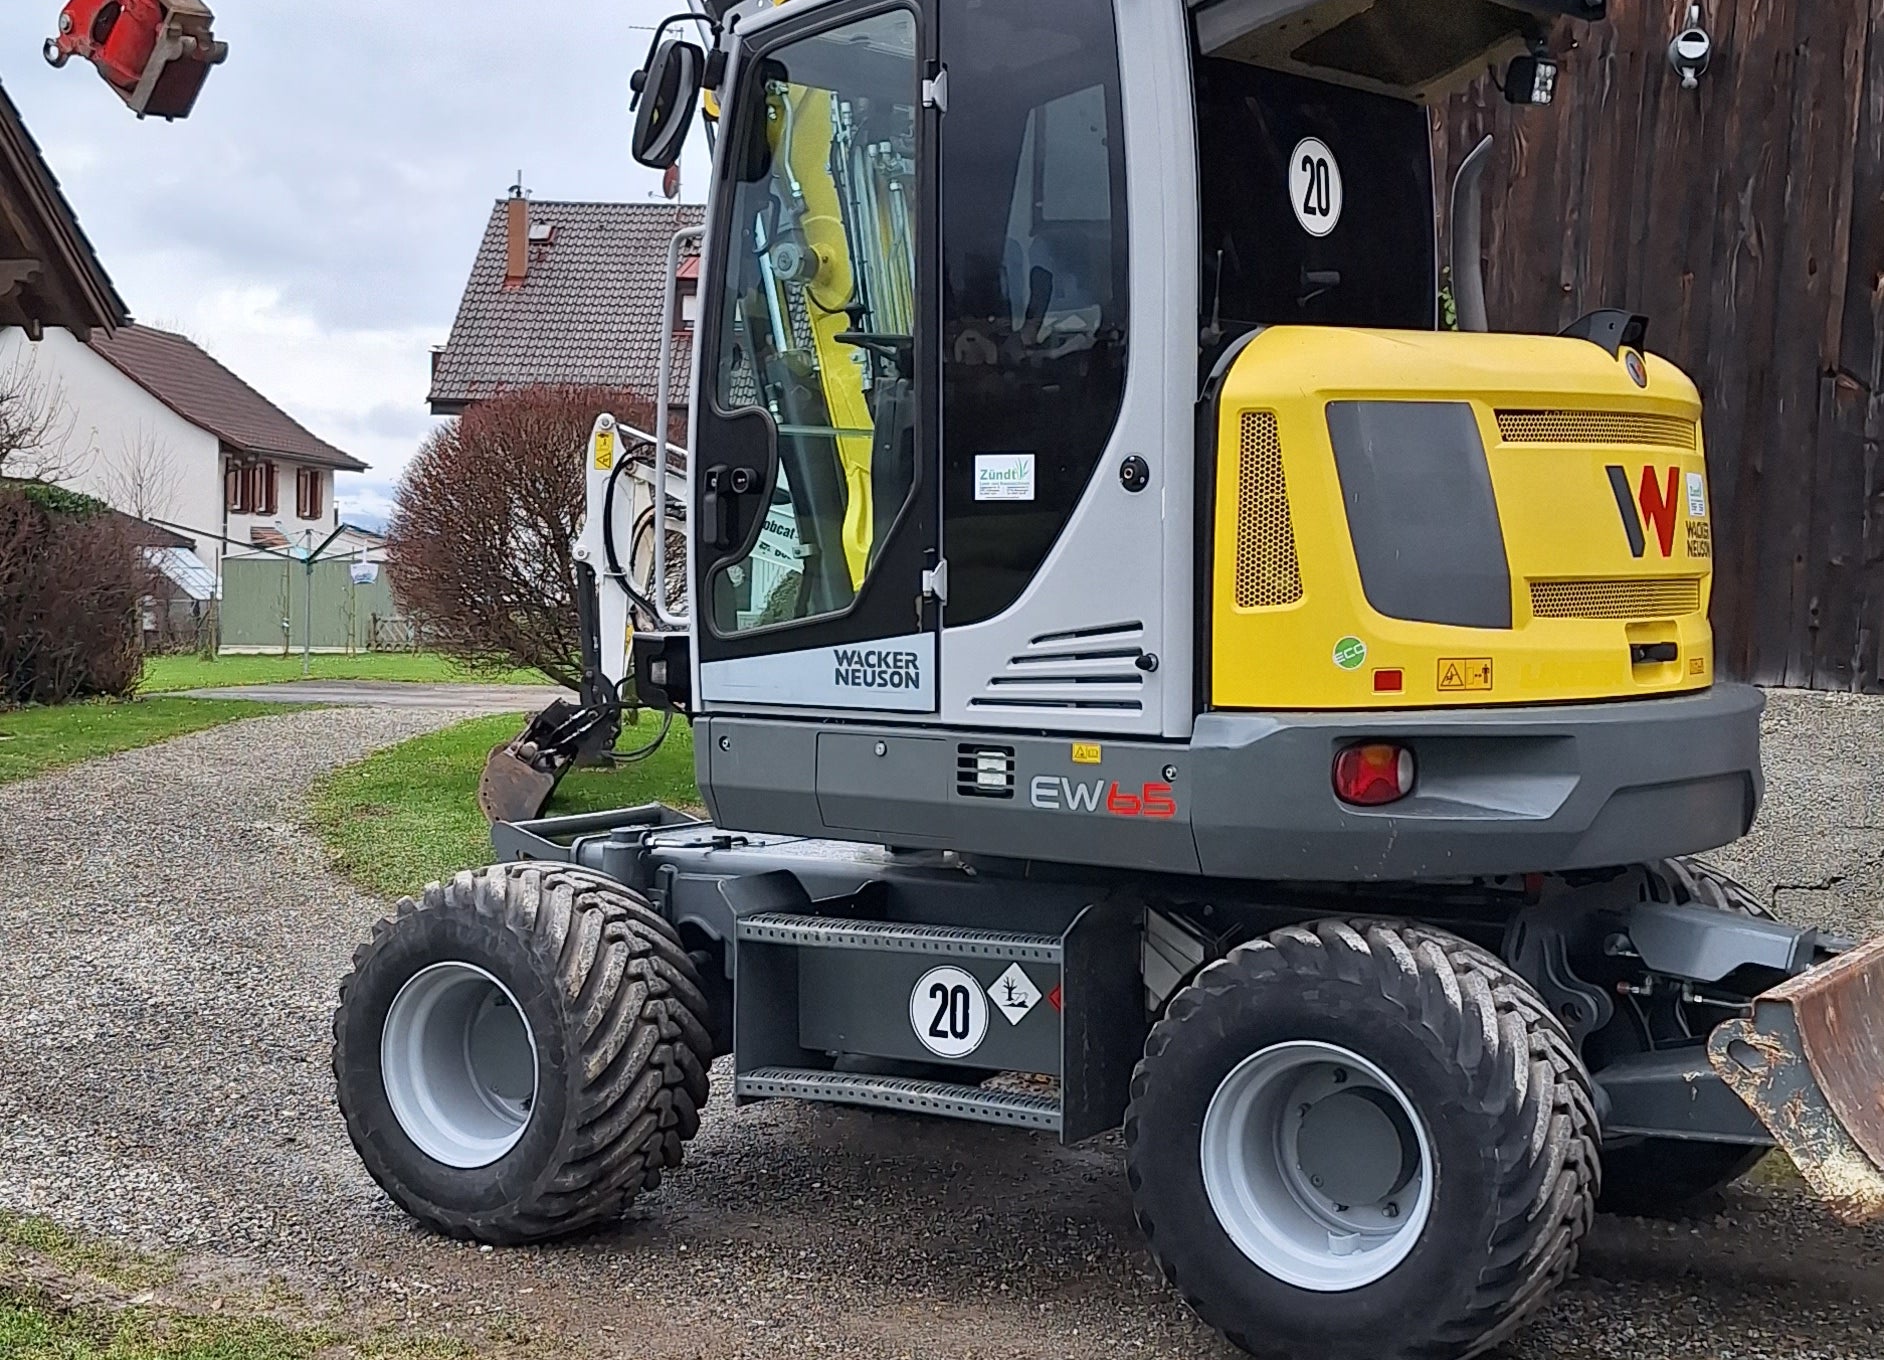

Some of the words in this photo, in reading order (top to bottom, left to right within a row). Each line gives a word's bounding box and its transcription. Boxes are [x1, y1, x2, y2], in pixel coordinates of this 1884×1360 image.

[1302, 155, 1330, 217] 20
[980, 469, 1017, 480] Zündt
[833, 649, 919, 670] WACKER
[1334, 643, 1366, 662] ECO
[835, 668, 919, 689] NEUSON
[1031, 775, 1177, 818] EW65
[929, 983, 970, 1040] 20
